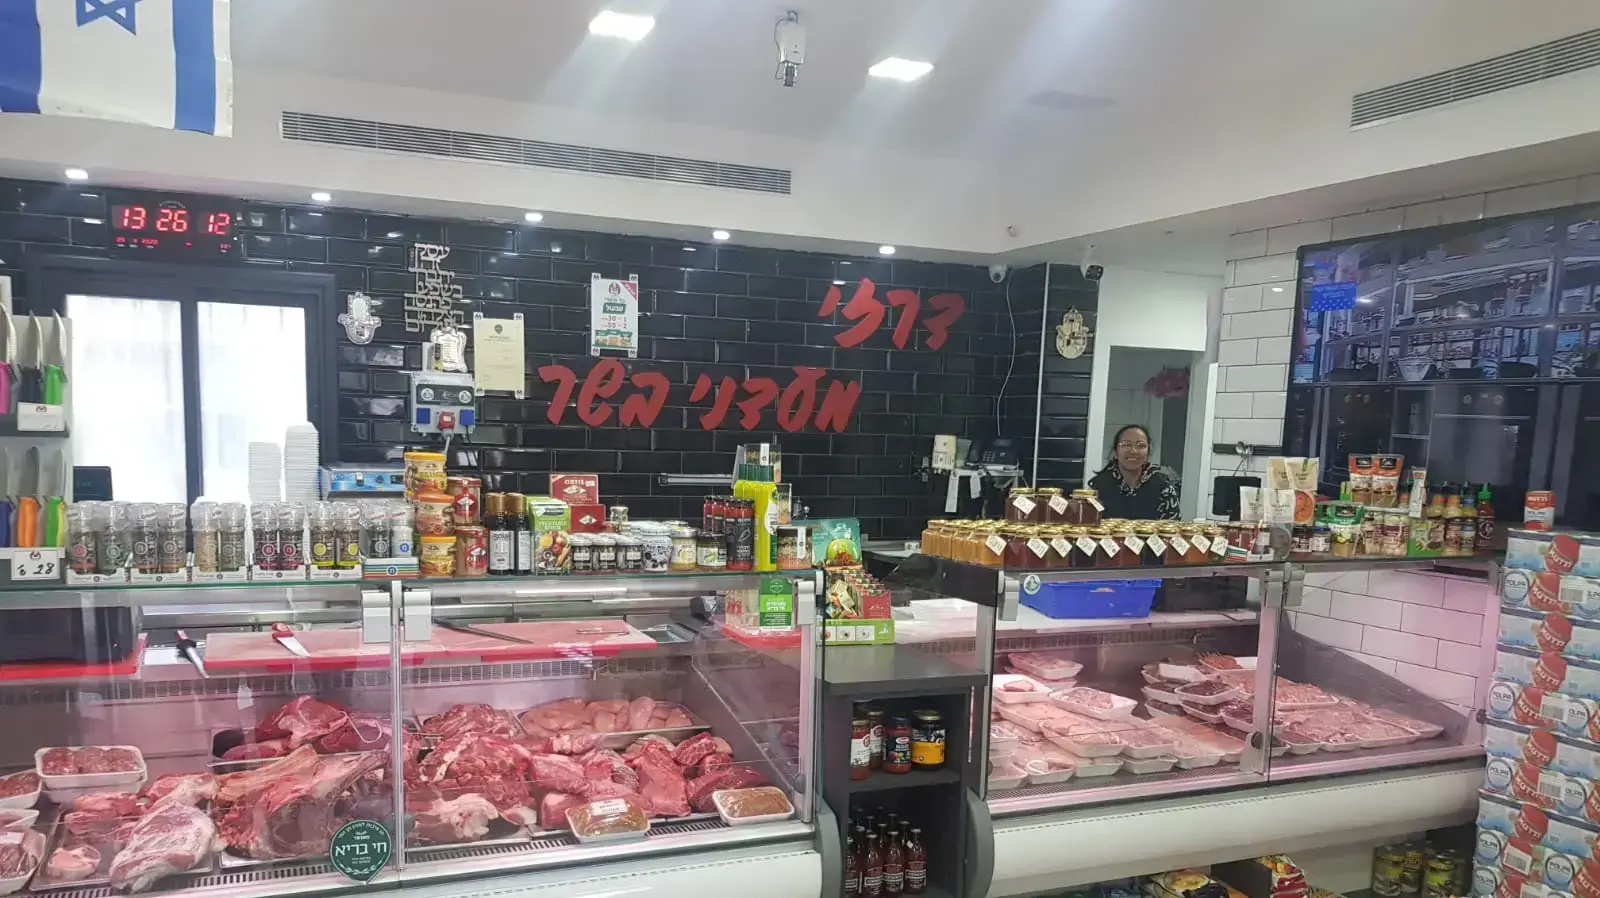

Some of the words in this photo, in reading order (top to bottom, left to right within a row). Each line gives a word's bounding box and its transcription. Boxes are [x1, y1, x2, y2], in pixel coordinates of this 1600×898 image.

[123, 207, 147, 229] 13
[156, 208, 188, 232] 26
[208, 213, 230, 235] 12
[538, 357, 670, 429] בשר
[689, 366, 862, 433] מעדני
[33, 563, 55, 575] 28
[1541, 628, 1565, 647] MUTTI
[1535, 665, 1559, 686] MUTTI
[1527, 743, 1550, 763] MUTTI
[335, 843, 369, 857] בריא
[372, 842, 387, 853] חי
[1549, 862, 1571, 873] POLPA
[1577, 873, 1600, 897] MUTT
